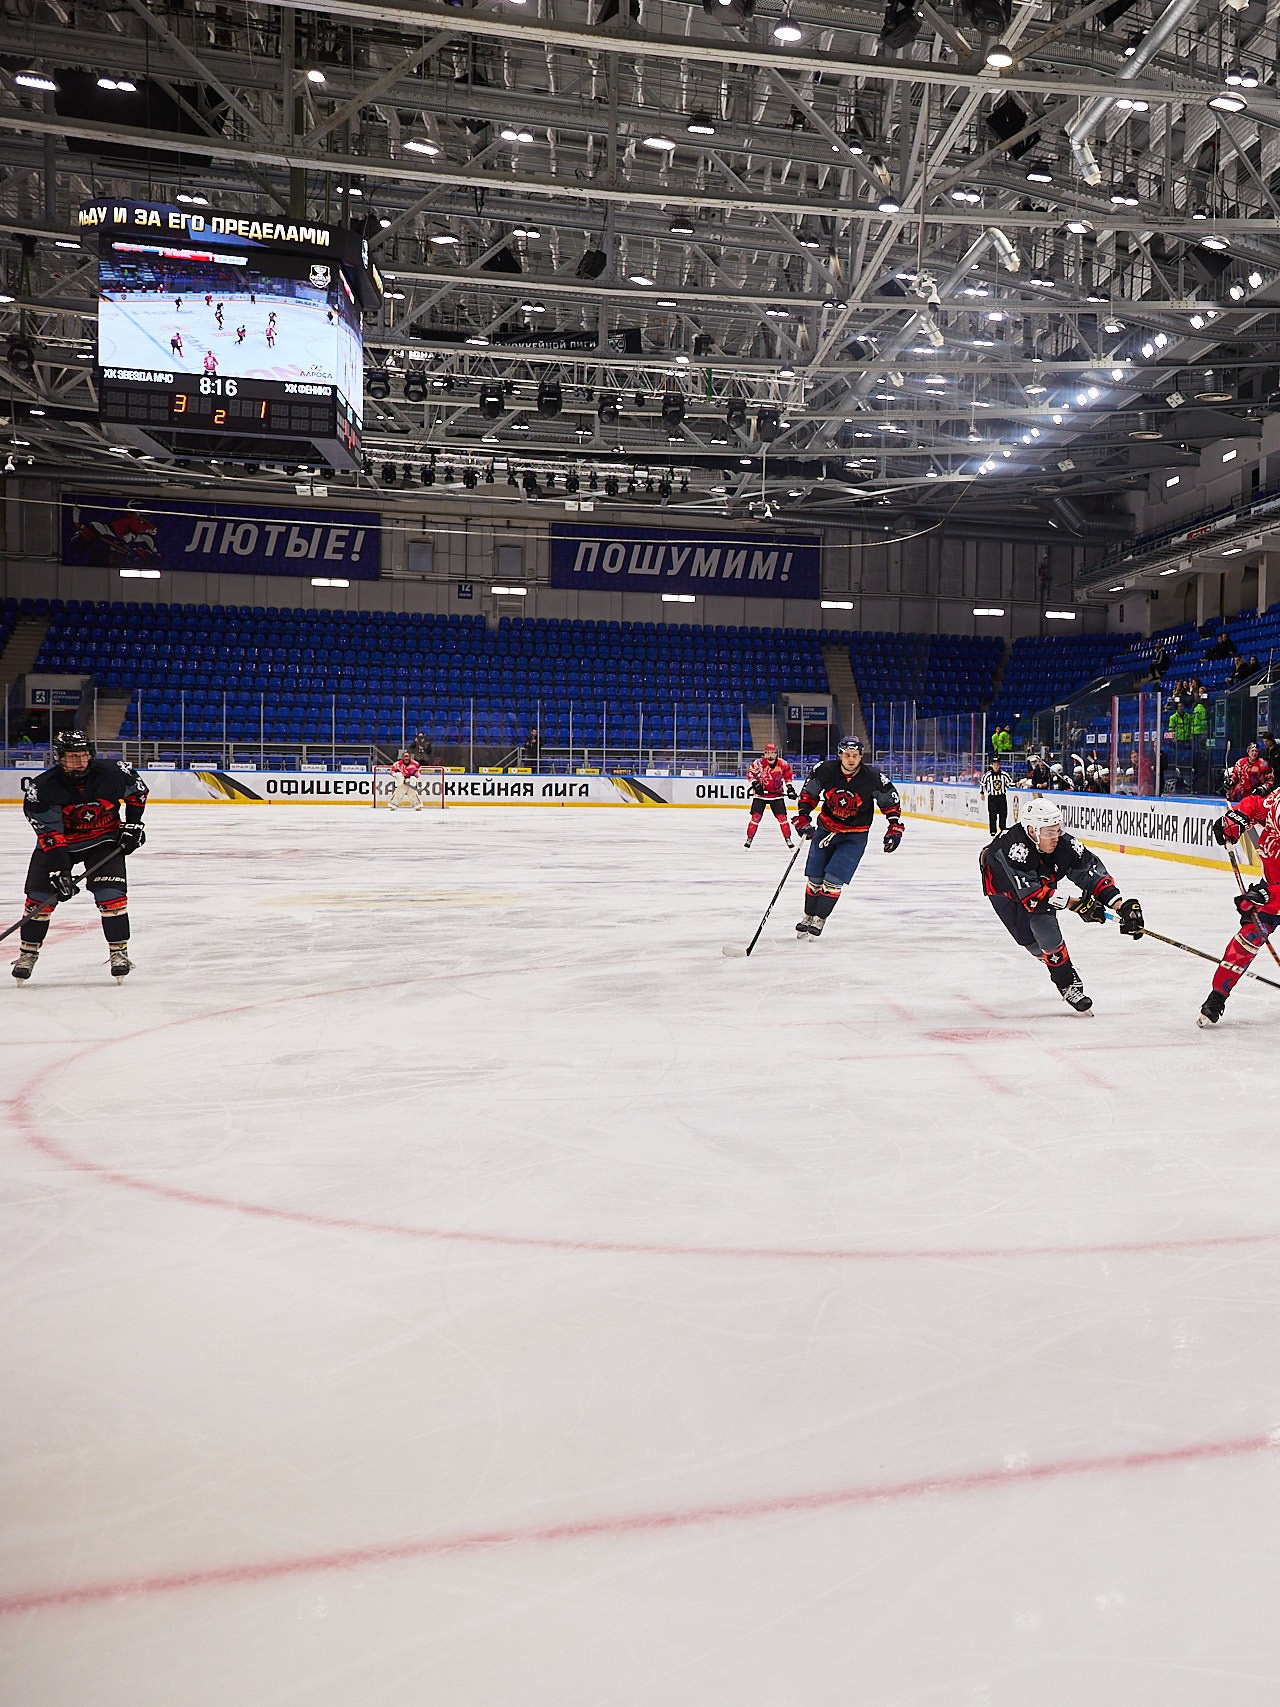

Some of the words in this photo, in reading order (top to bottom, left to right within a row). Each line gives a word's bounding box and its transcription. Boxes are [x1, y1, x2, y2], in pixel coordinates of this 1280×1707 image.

[113, 206, 127, 224] И
[134, 208, 161, 227] ЗА
[168, 212, 204, 231] ЕГО
[212, 217, 330, 246] ПРЕДЕЛАМИ
[199, 377, 238, 396] 8:16
[173, 394, 187, 412] 3
[213, 409, 226, 424] 2
[184, 520, 366, 562] ЛЮТЫЕ!
[573, 542, 793, 581] ПОШУМИМ!
[266, 779, 396, 795] ОФИЦЕРСКА
[542, 783, 589, 797] ЛИГА
[1056, 804, 1113, 833] ФИЦЕРСКАЯ
[1116, 805, 1178, 843] ХОККЕЙНАЯ
[1182, 816, 1214, 847] ЛИГА
